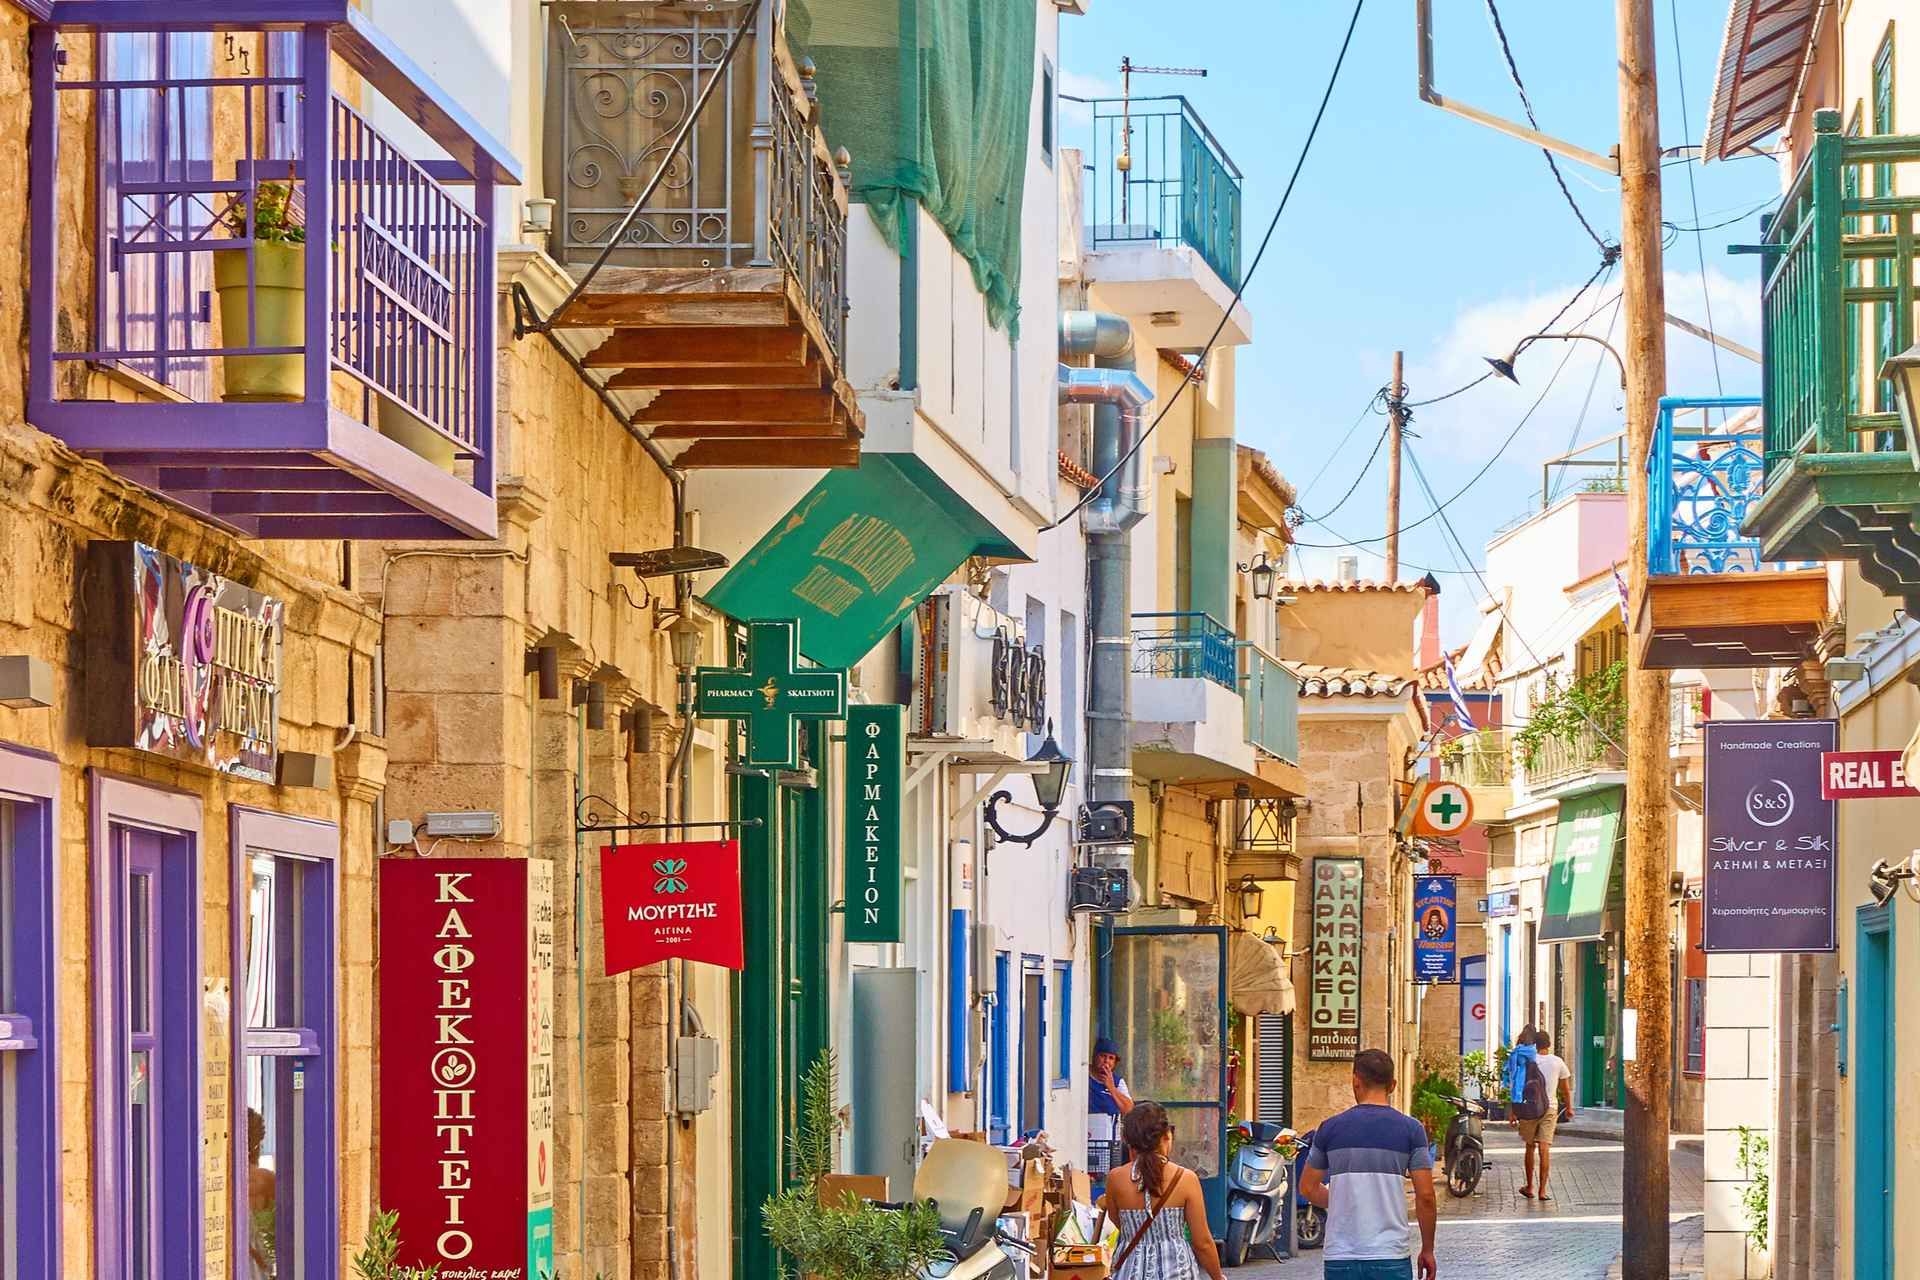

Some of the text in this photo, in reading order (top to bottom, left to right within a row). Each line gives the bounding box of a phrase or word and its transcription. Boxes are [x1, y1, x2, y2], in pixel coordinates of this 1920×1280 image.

[706, 689, 835, 697] PHARMACY SKALTSIOTI
[1720, 740, 1821, 750] Handmade Creations
[1829, 761, 1886, 789] REAL
[1753, 793, 1787, 809] S&S
[863, 722, 881, 924] ΦΑΡΜΑΚΕΙΟΝ
[1710, 834, 1830, 852] Silver & Silk
[1713, 859, 1827, 870] ΑΣΗΜΙ & ΜΕΤΑΞΙ
[627, 902, 718, 921] ΜΟΥΡΤΖΗΣ
[1712, 905, 1827, 917] Χειροποίητες Δημιουργίες
[654, 926, 692, 935] ΑΙΓΙΝΑ
[1314, 864, 1335, 1025] ΦΑΡΜΑΚΕΙΟ
[1338, 865, 1359, 1025] PHARMACIE
[431, 872, 476, 1260] ΚΑΦΕΚΟΠΤΕΙΟ
[530, 1063, 551, 1099] TEA
